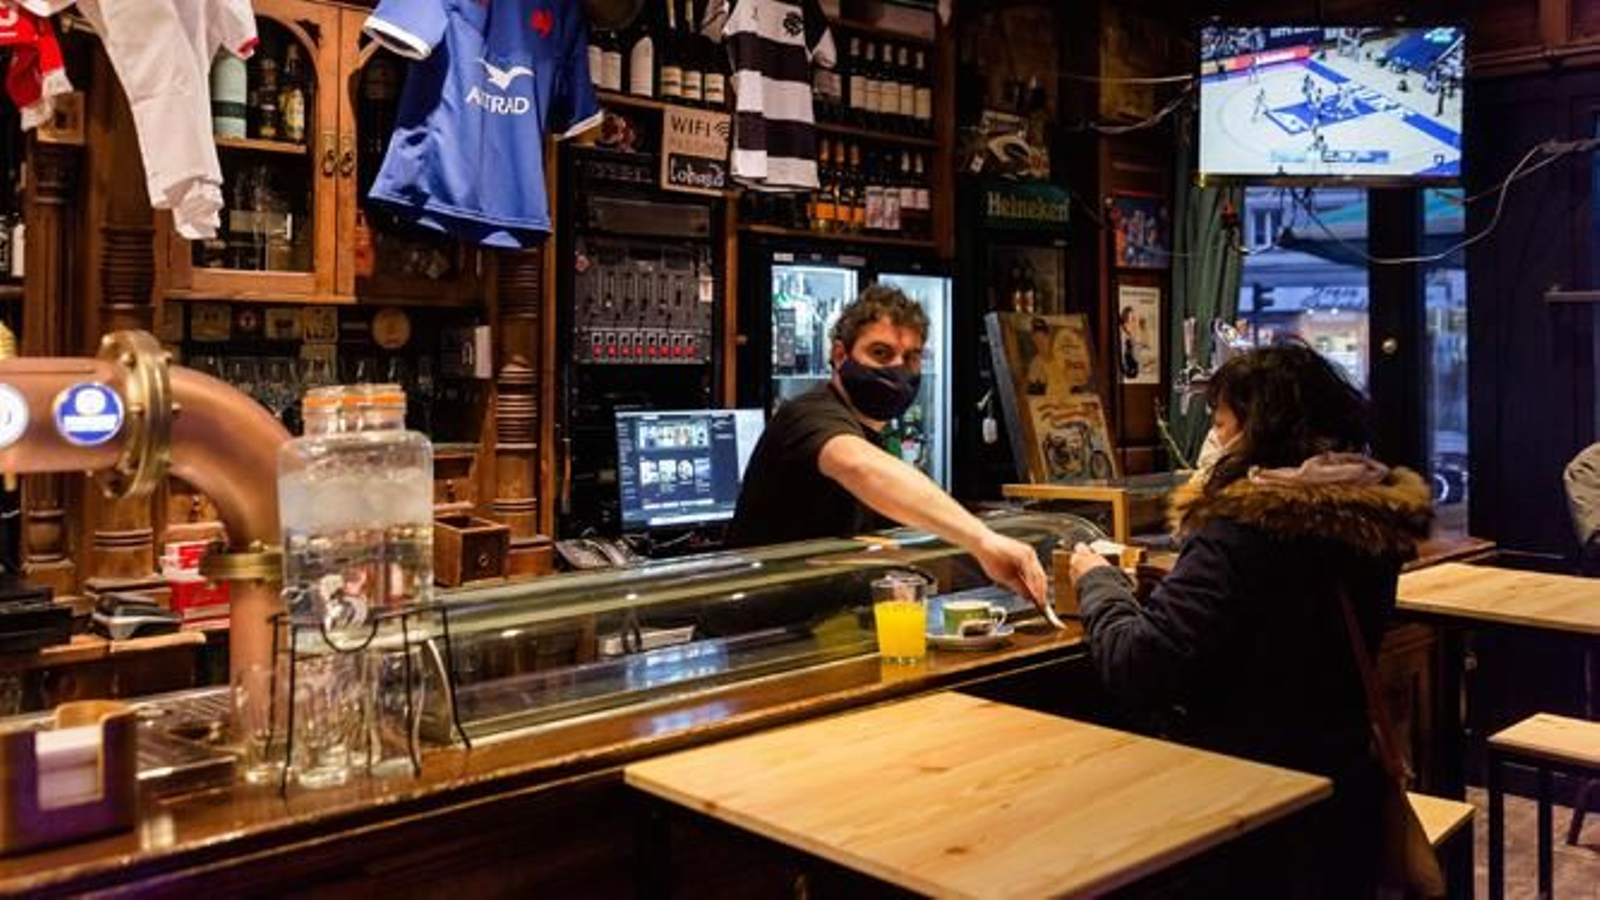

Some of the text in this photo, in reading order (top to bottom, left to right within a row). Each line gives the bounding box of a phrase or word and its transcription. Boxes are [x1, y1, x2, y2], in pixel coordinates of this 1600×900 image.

[465, 86, 530, 114] ATRAD
[670, 114, 711, 137] WIFI
[986, 190, 1070, 222] Heineken
